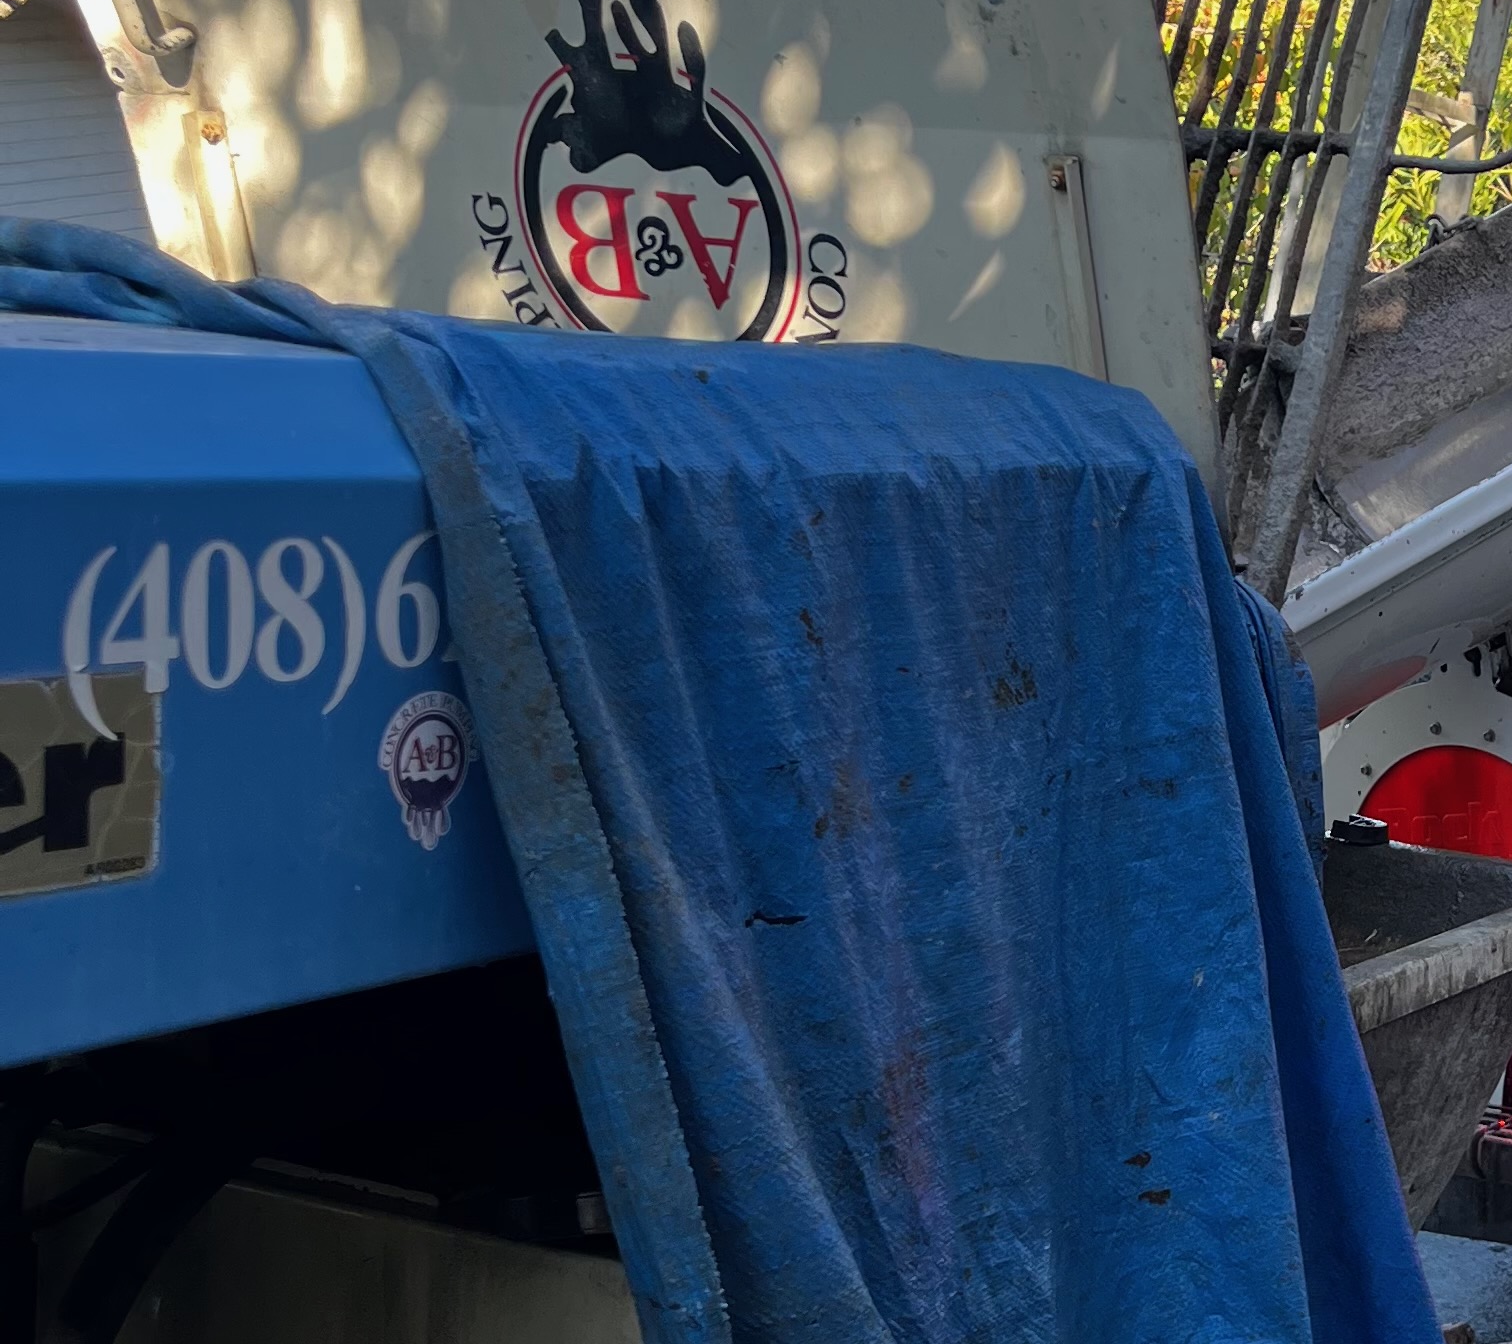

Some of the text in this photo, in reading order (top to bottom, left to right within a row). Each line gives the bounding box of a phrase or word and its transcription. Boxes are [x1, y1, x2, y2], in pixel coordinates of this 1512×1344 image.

[471, 192, 562, 329] PING
[555, 183, 759, 311] A&B
[63, 530, 463, 741] (408)6
[402, 735, 458, 774] A&B
